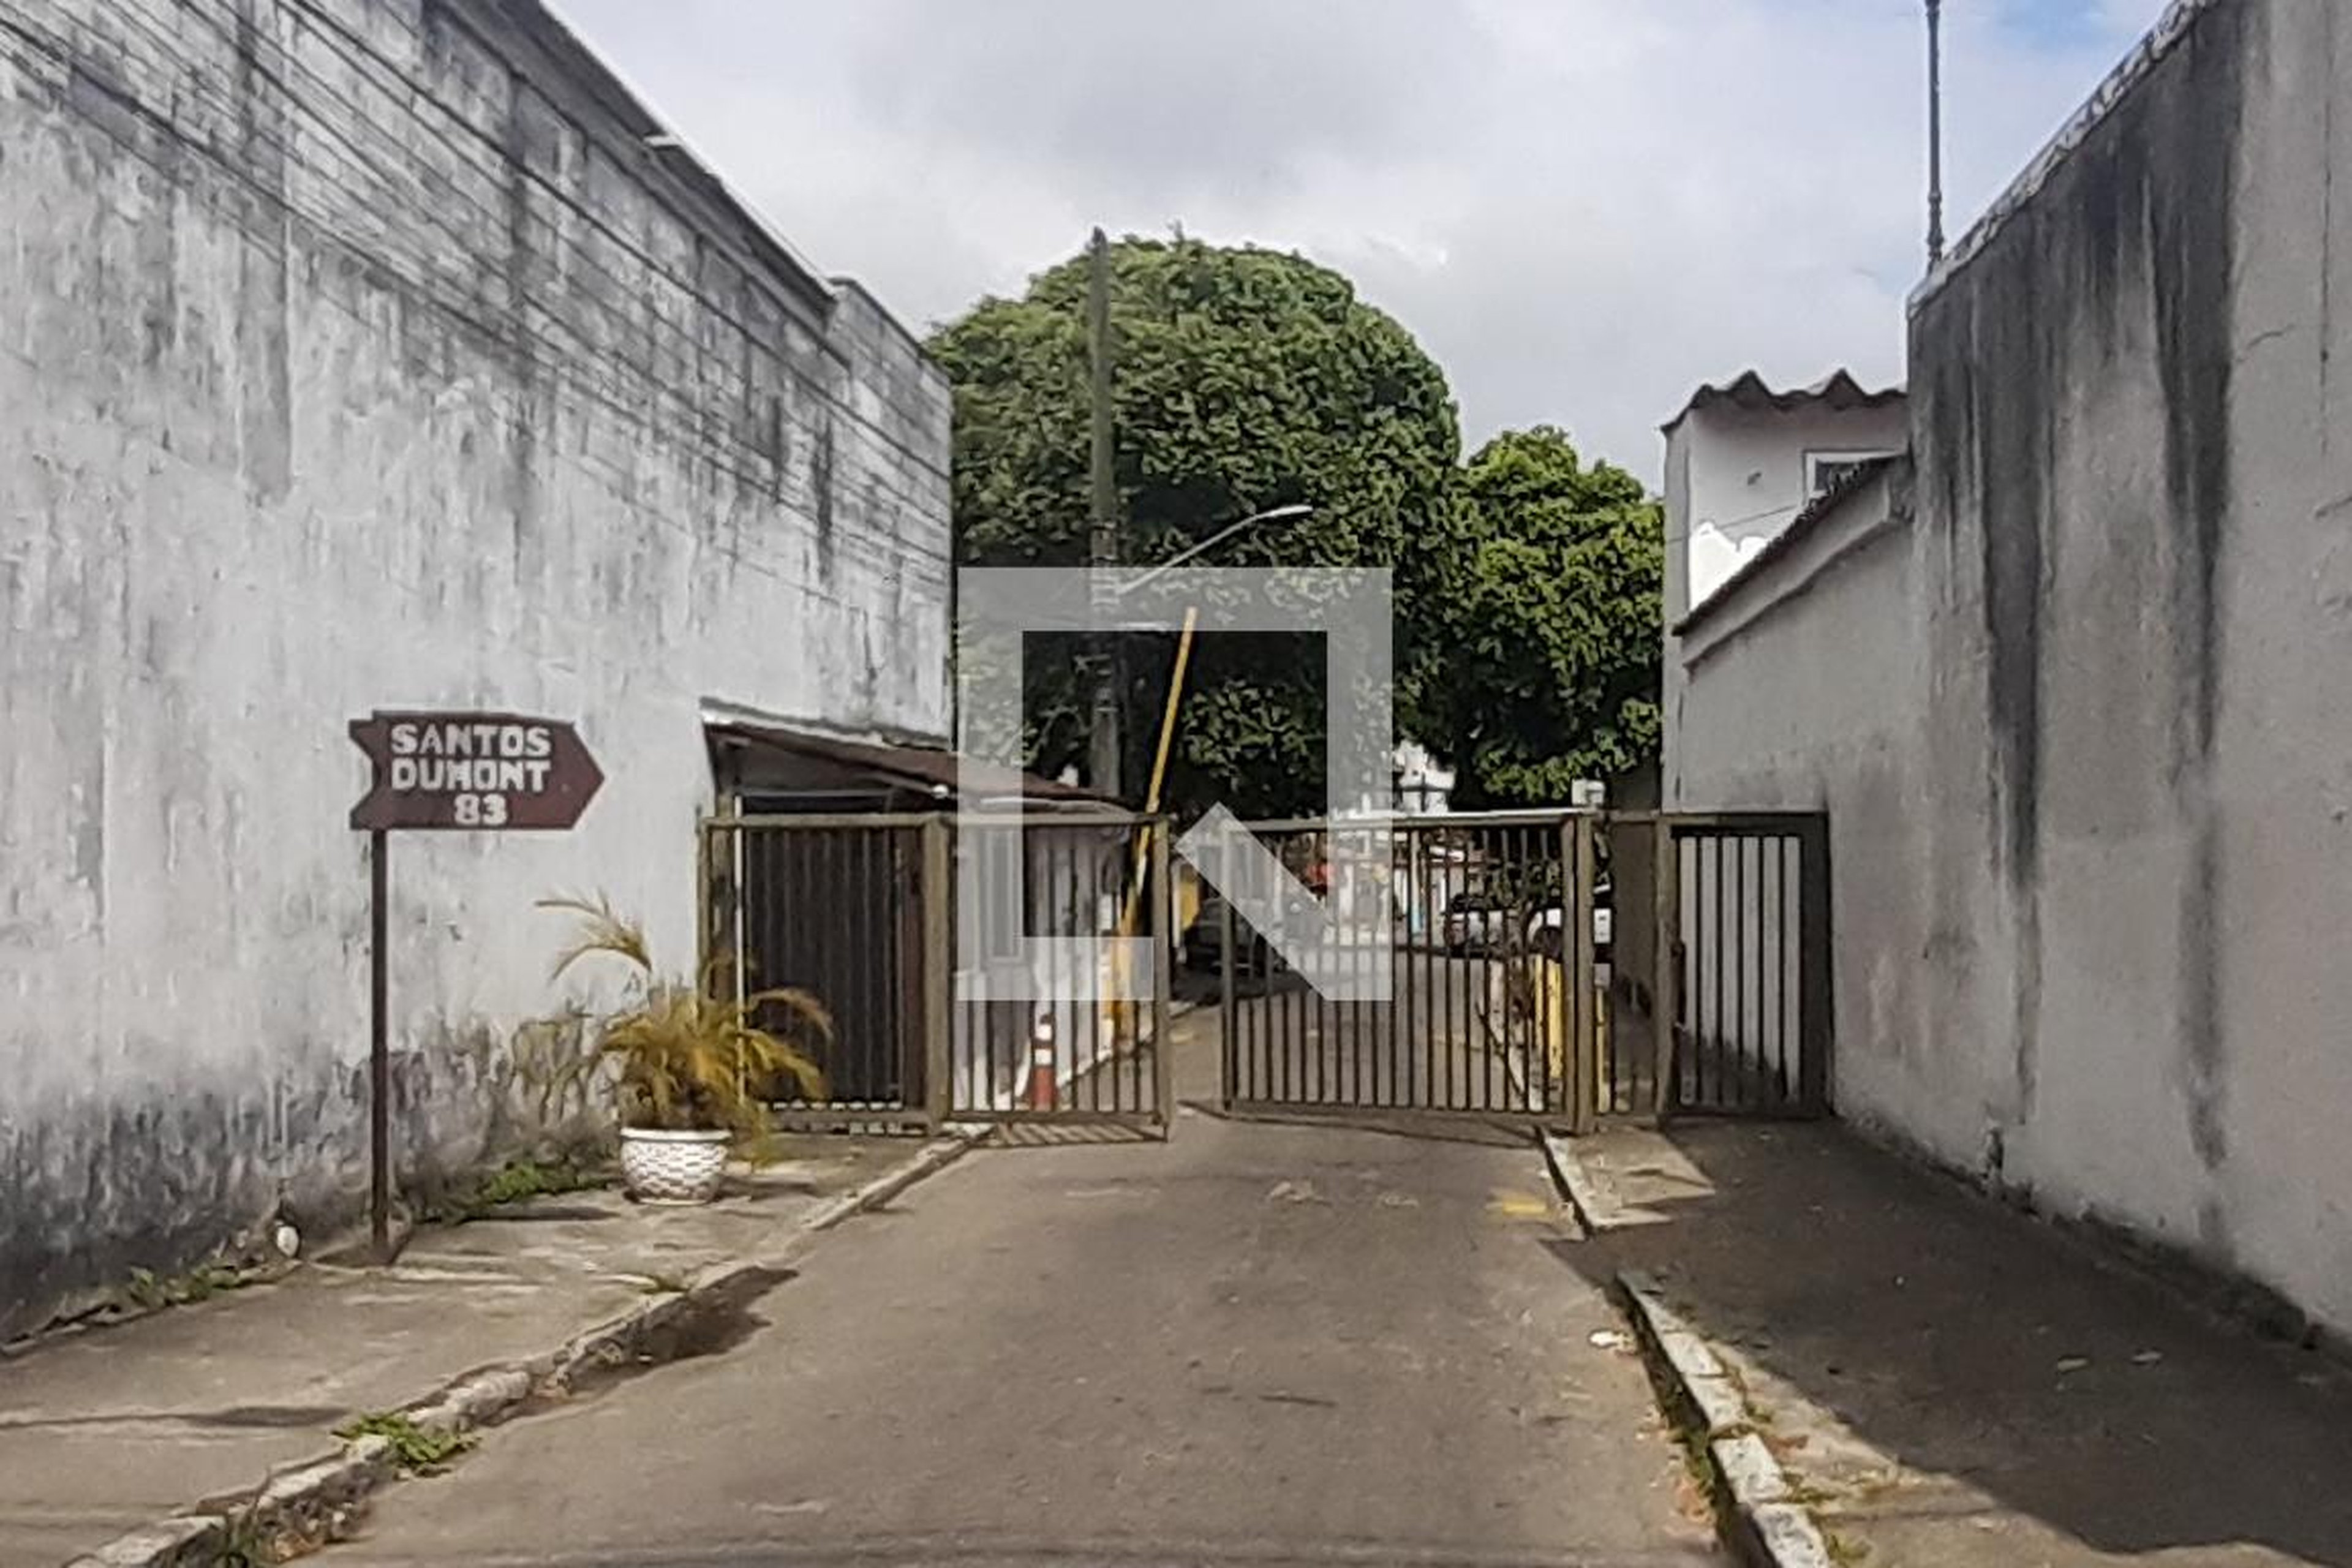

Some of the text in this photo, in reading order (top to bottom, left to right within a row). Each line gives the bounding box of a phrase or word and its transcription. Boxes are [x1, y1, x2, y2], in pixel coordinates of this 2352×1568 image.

[390, 723, 551, 757] SANTOS
[391, 758, 551, 791] DUMONT
[453, 793, 508, 826] 83
